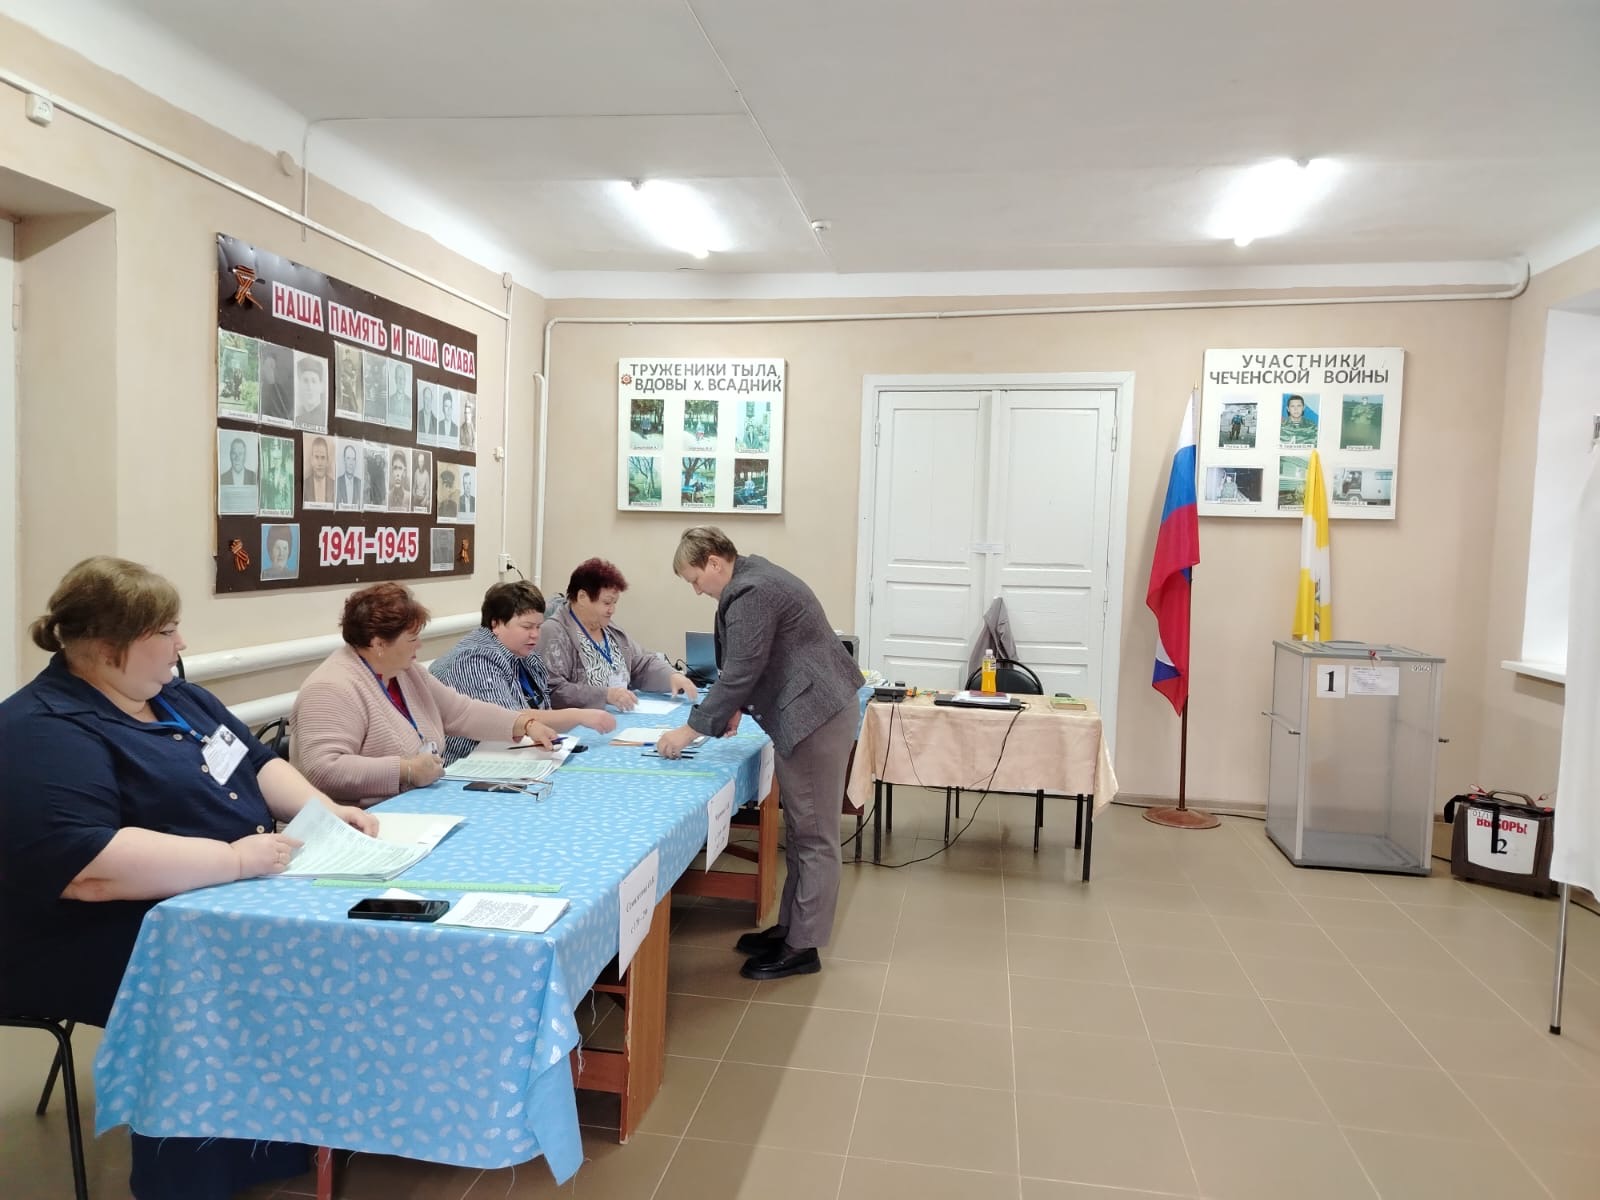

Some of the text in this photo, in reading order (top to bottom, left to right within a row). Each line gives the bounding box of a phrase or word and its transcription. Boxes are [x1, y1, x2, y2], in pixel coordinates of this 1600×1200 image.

[274, 287, 475, 375] НАША ПАМЯТЬ И НАША СЛАВА
[1242, 354, 1366, 369] УЧАСТНИКИ
[630, 363, 781, 379] ТРУЖЕНИКИ ТЫЛА,
[1209, 366, 1389, 385] ЧЕЧЕНСКОЙ ВОЙНЫ
[635, 378, 686, 393] ВДОВЫ
[708, 377, 782, 394] ВСАДНИК
[1325, 670, 1336, 692] 1
